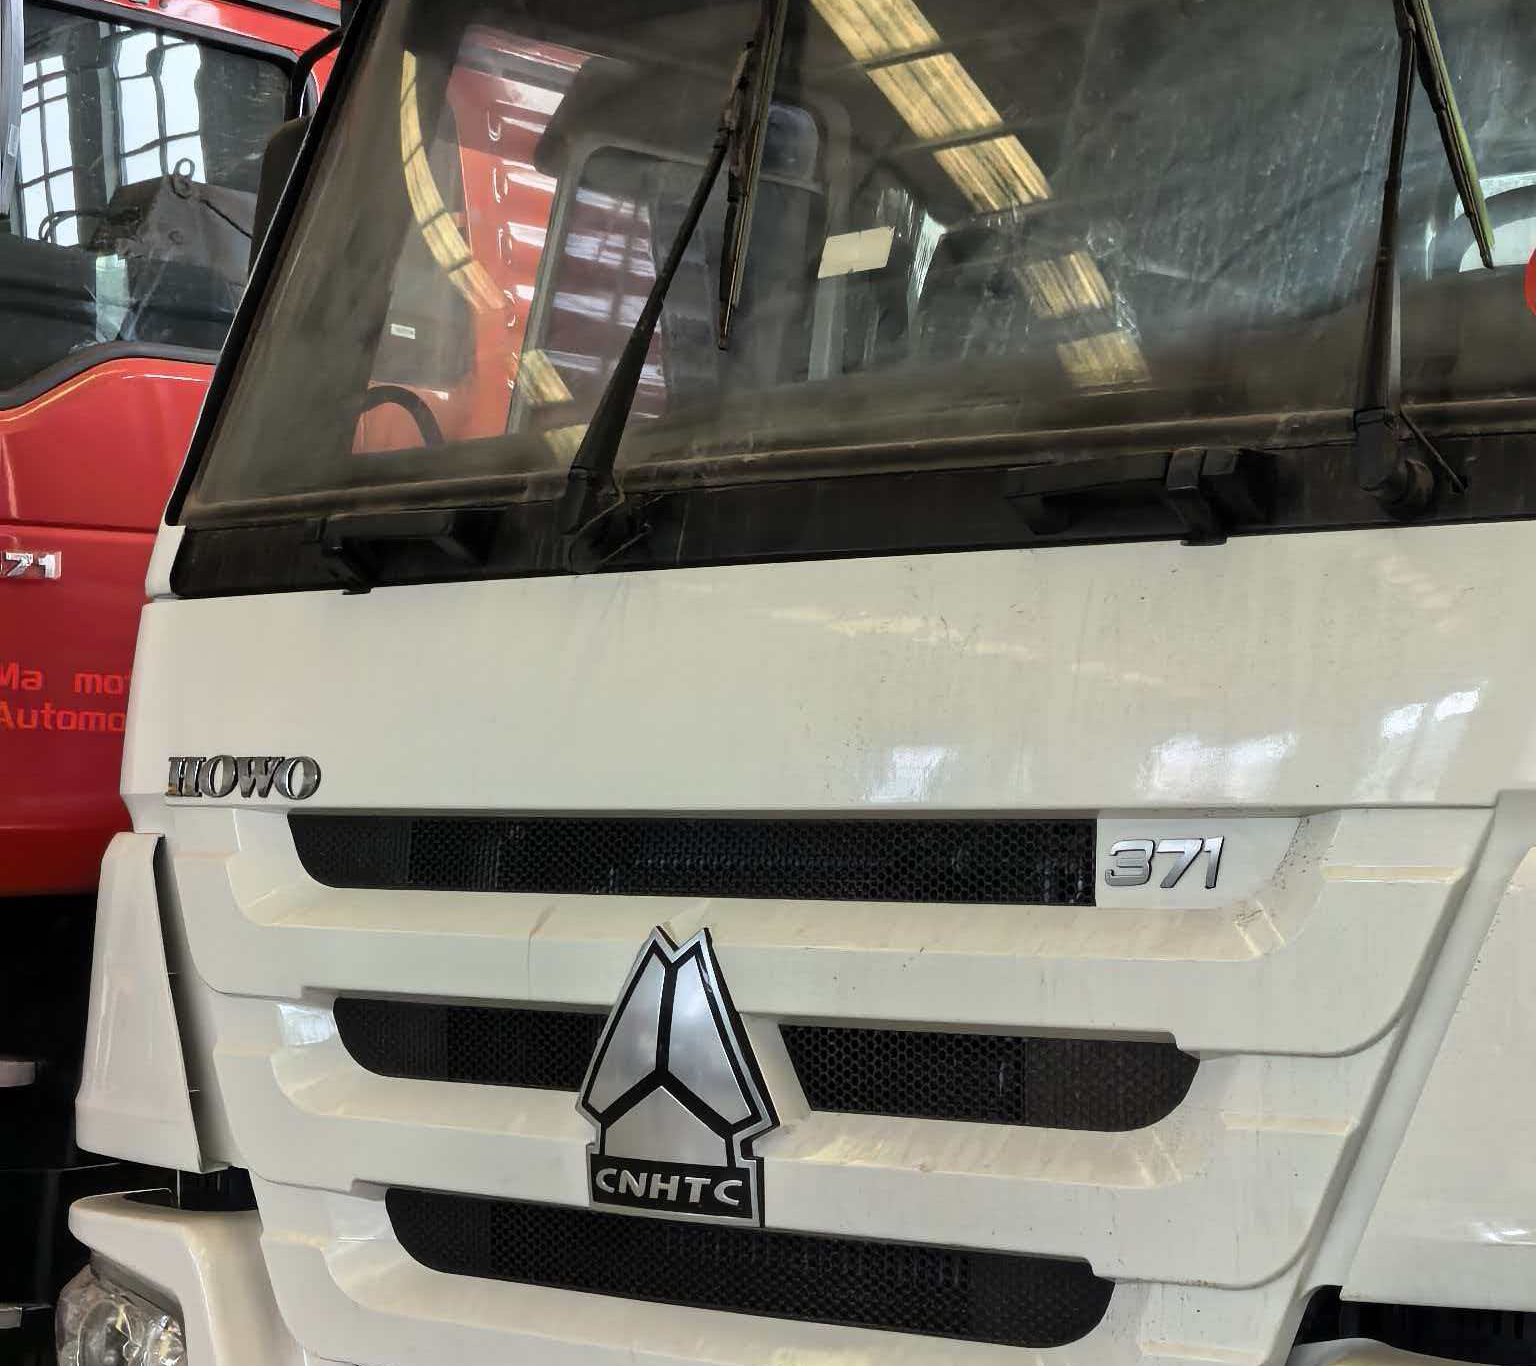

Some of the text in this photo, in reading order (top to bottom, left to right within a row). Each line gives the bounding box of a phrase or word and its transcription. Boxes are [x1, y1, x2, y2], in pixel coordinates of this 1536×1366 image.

[0, 551, 62, 580] 71
[74, 673, 130, 695] mo
[166, 755, 322, 799] HOWO
[1105, 836, 1225, 889] 371
[595, 1167, 743, 1206] CNHTC
